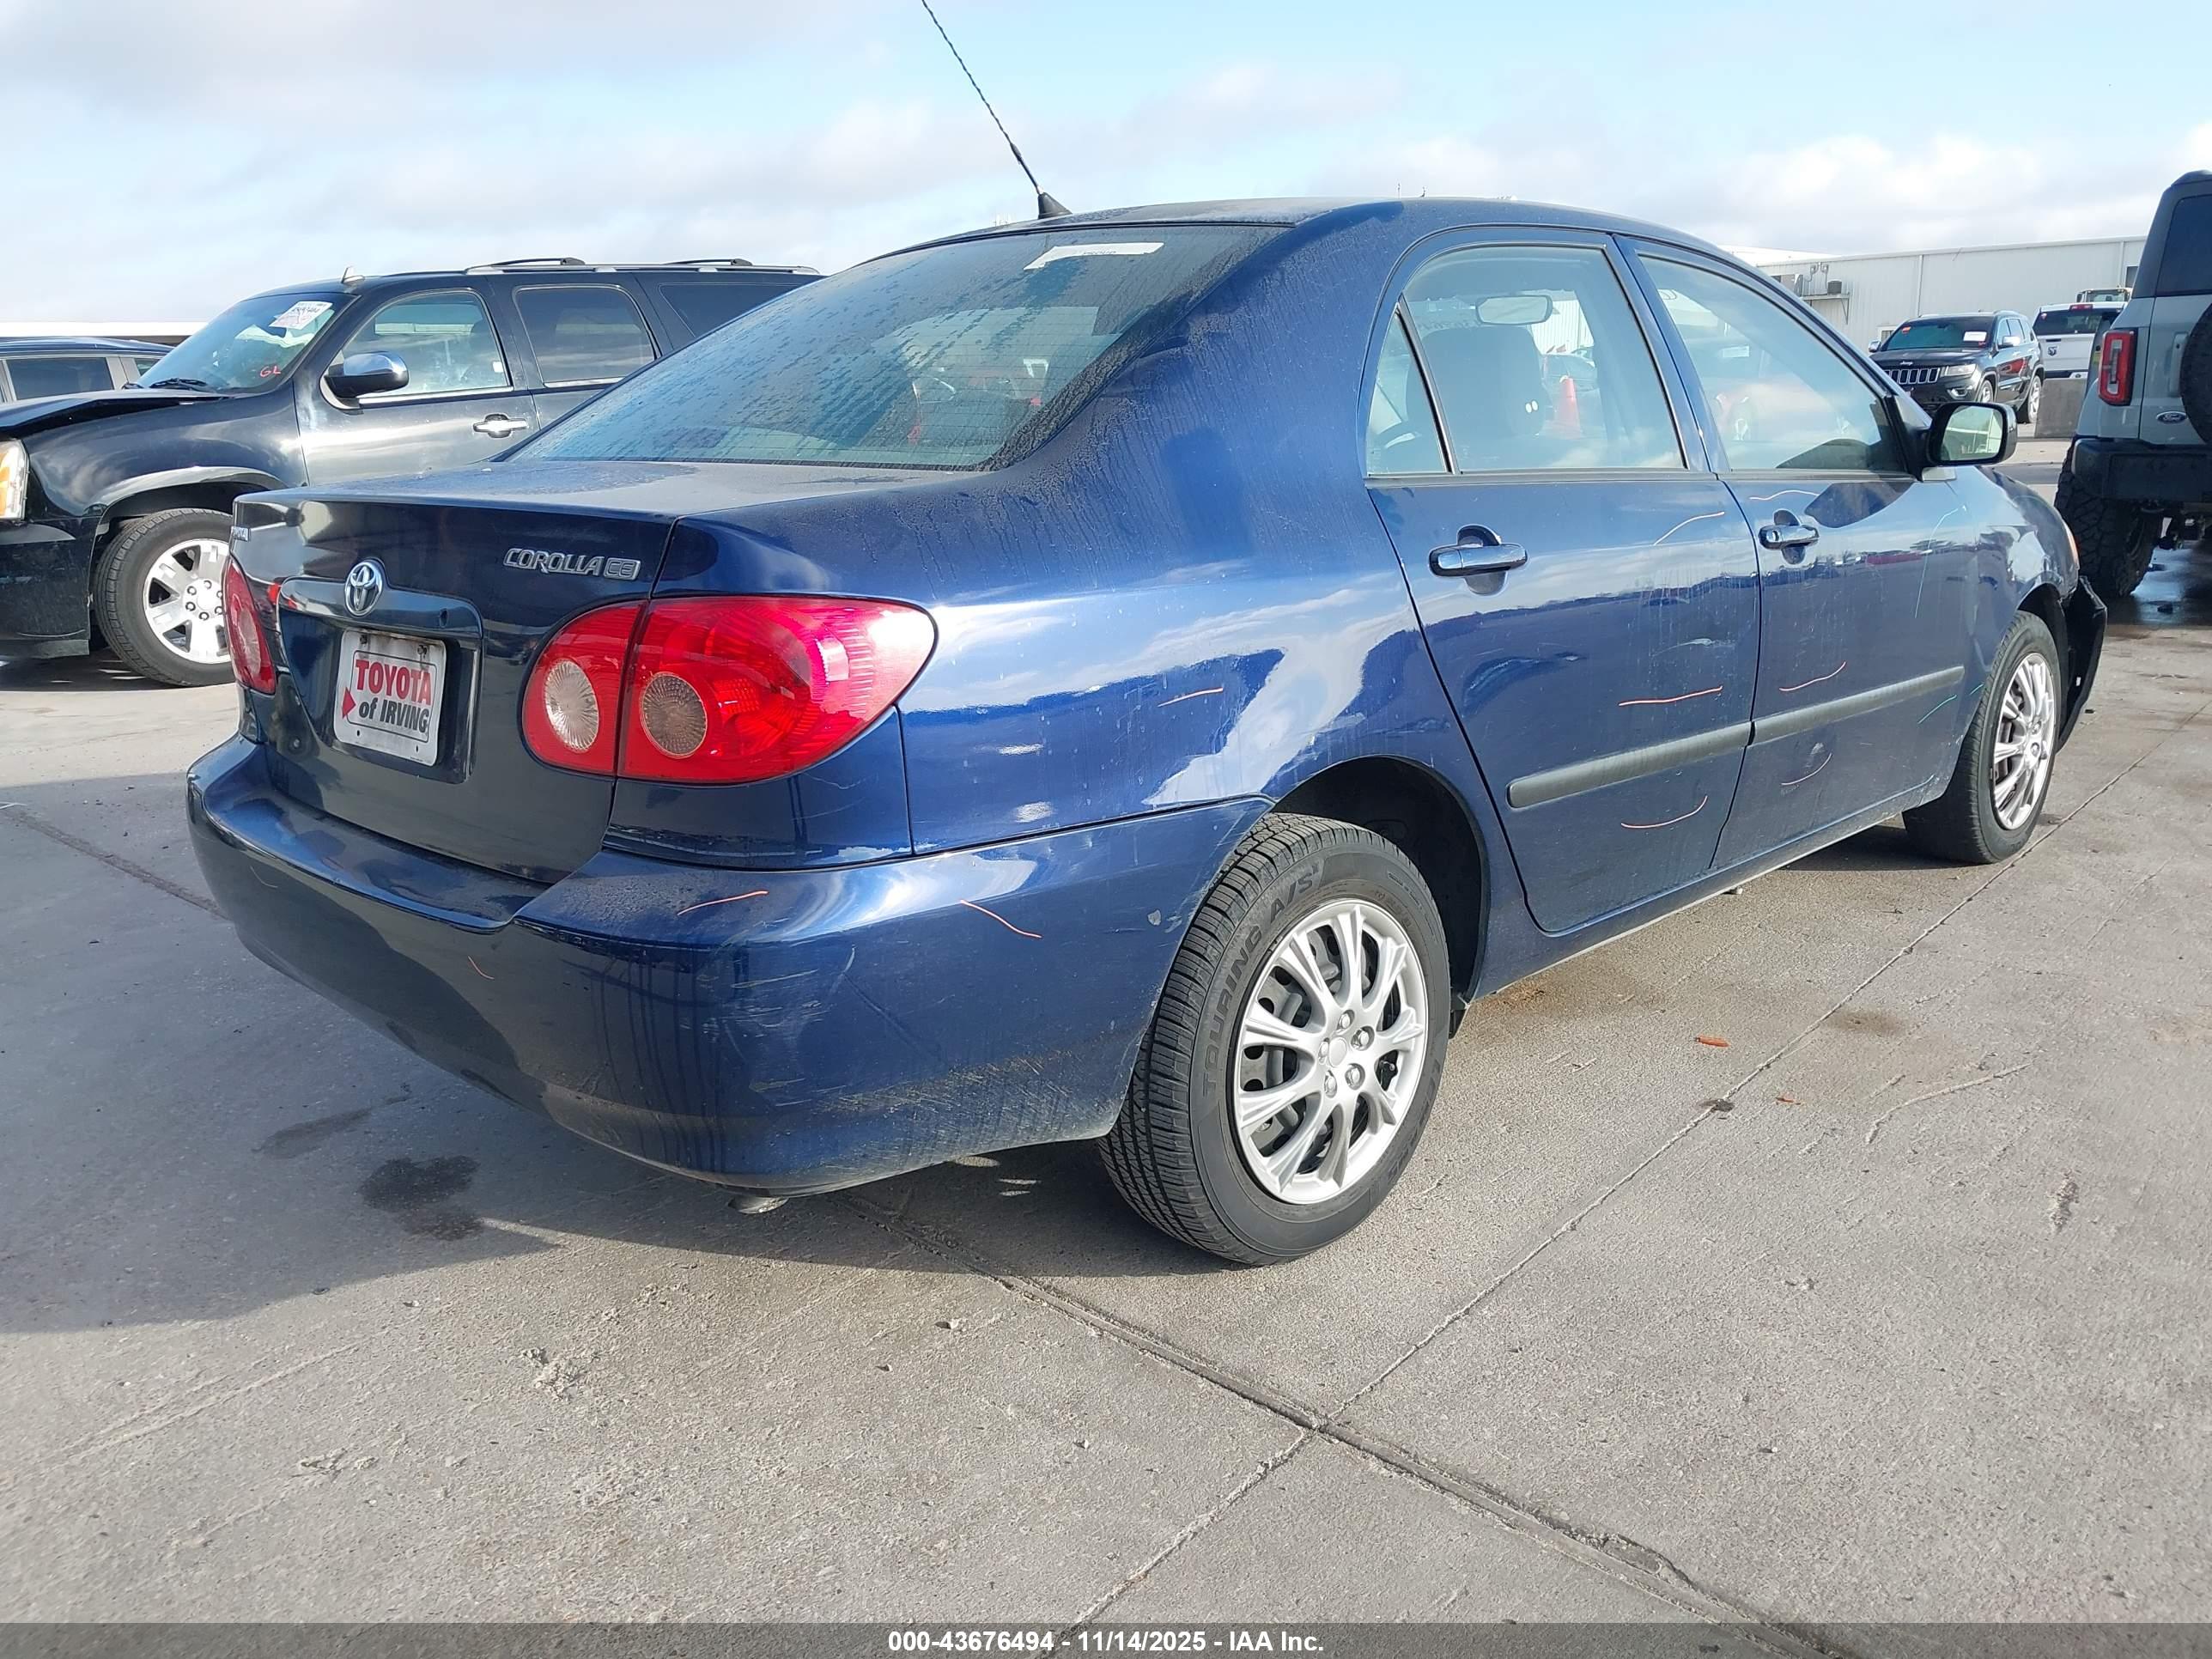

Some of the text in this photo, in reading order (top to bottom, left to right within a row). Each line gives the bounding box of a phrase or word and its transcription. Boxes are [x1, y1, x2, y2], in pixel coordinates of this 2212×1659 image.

[503, 548, 638, 578] COROLLA CE
[356, 659, 432, 706] TOYOTA
[358, 697, 430, 733] of IRVING
[1203, 924, 1262, 1097] TOURING
